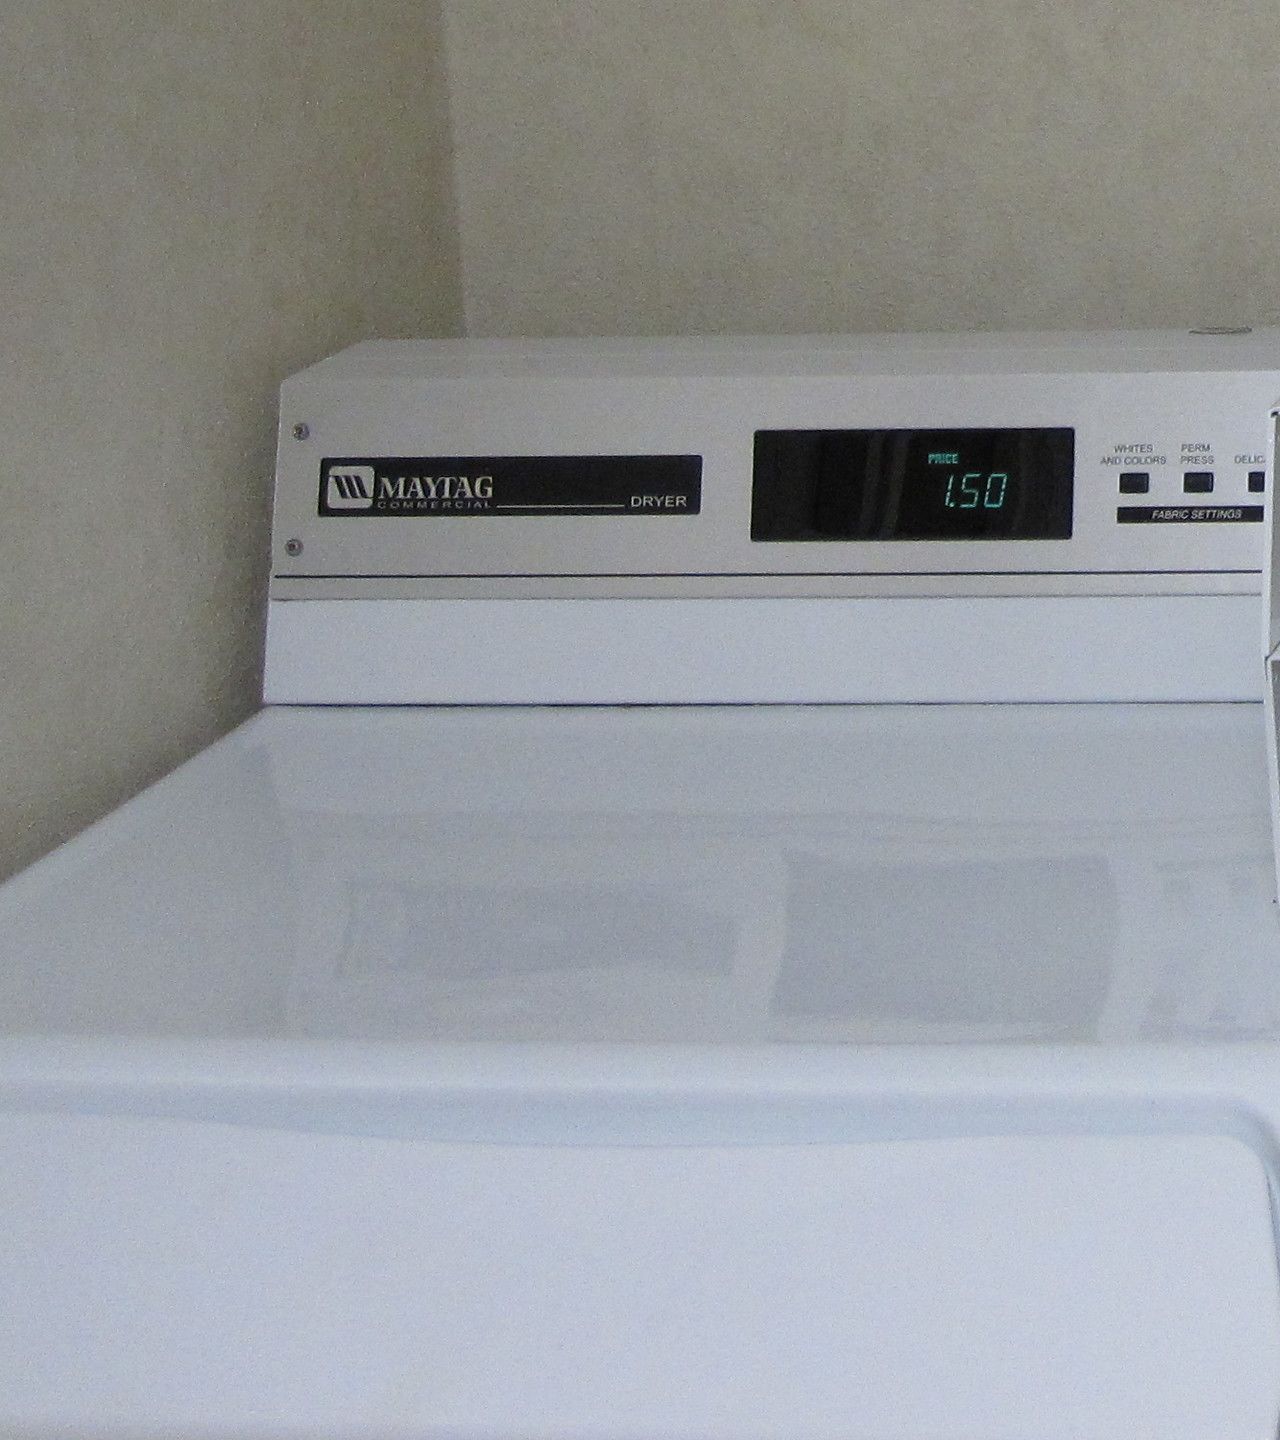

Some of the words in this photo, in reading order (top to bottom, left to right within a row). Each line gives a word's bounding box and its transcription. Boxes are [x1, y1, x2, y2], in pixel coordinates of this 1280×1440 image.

[1113, 443, 1154, 453] WHITES
[928, 452, 959, 465] PRICE
[1100, 456, 1122, 466] AND
[1124, 455, 1167, 466] COLORS
[1180, 455, 1215, 465] PRESS
[376, 475, 494, 499] MAYTAG
[944, 472, 1009, 509] 1.50
[376, 500, 491, 510] COMMERCIAL
[630, 495, 688, 508] DRYER
[1151, 510, 1189, 521] FABRIC
[1190, 509, 1242, 520] SETTINGS
